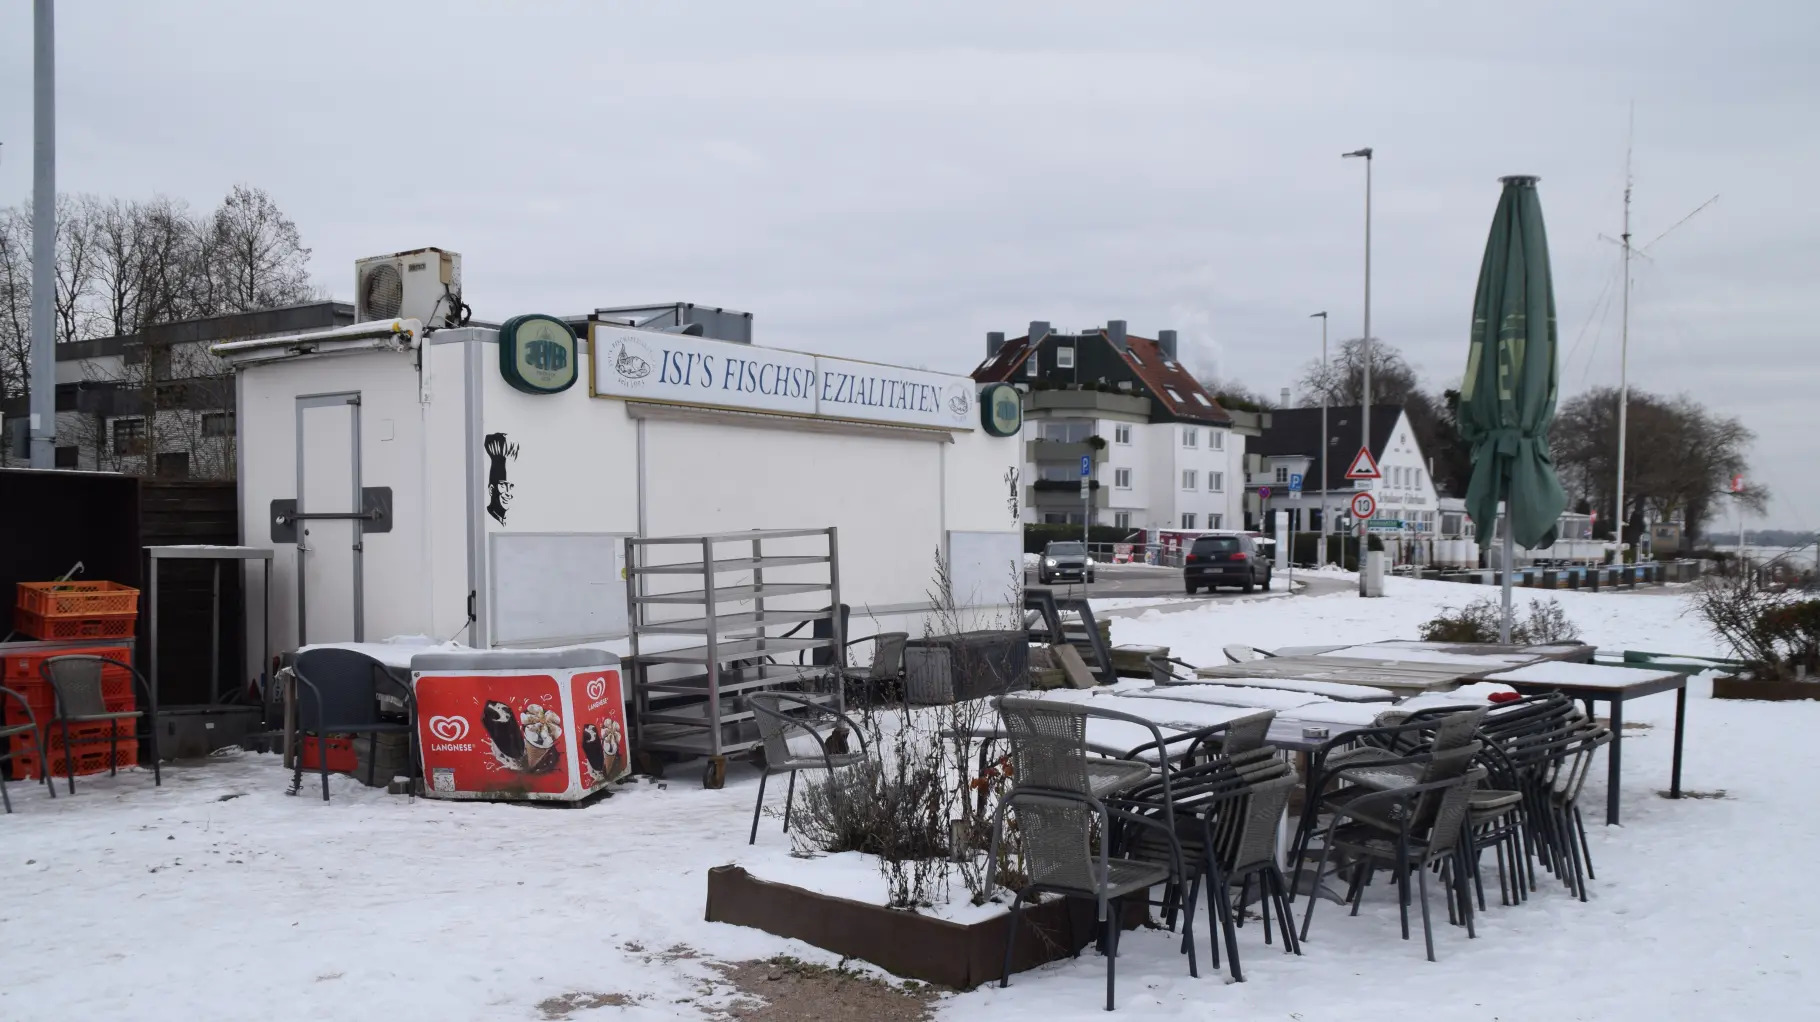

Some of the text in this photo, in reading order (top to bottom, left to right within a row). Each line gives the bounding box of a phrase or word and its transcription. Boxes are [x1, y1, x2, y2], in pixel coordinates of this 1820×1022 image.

[658, 349, 714, 389] ISI'S
[722, 357, 943, 414] FISCHSPEZIALITÄTEN
[431, 743, 473, 752] LANGNESE
